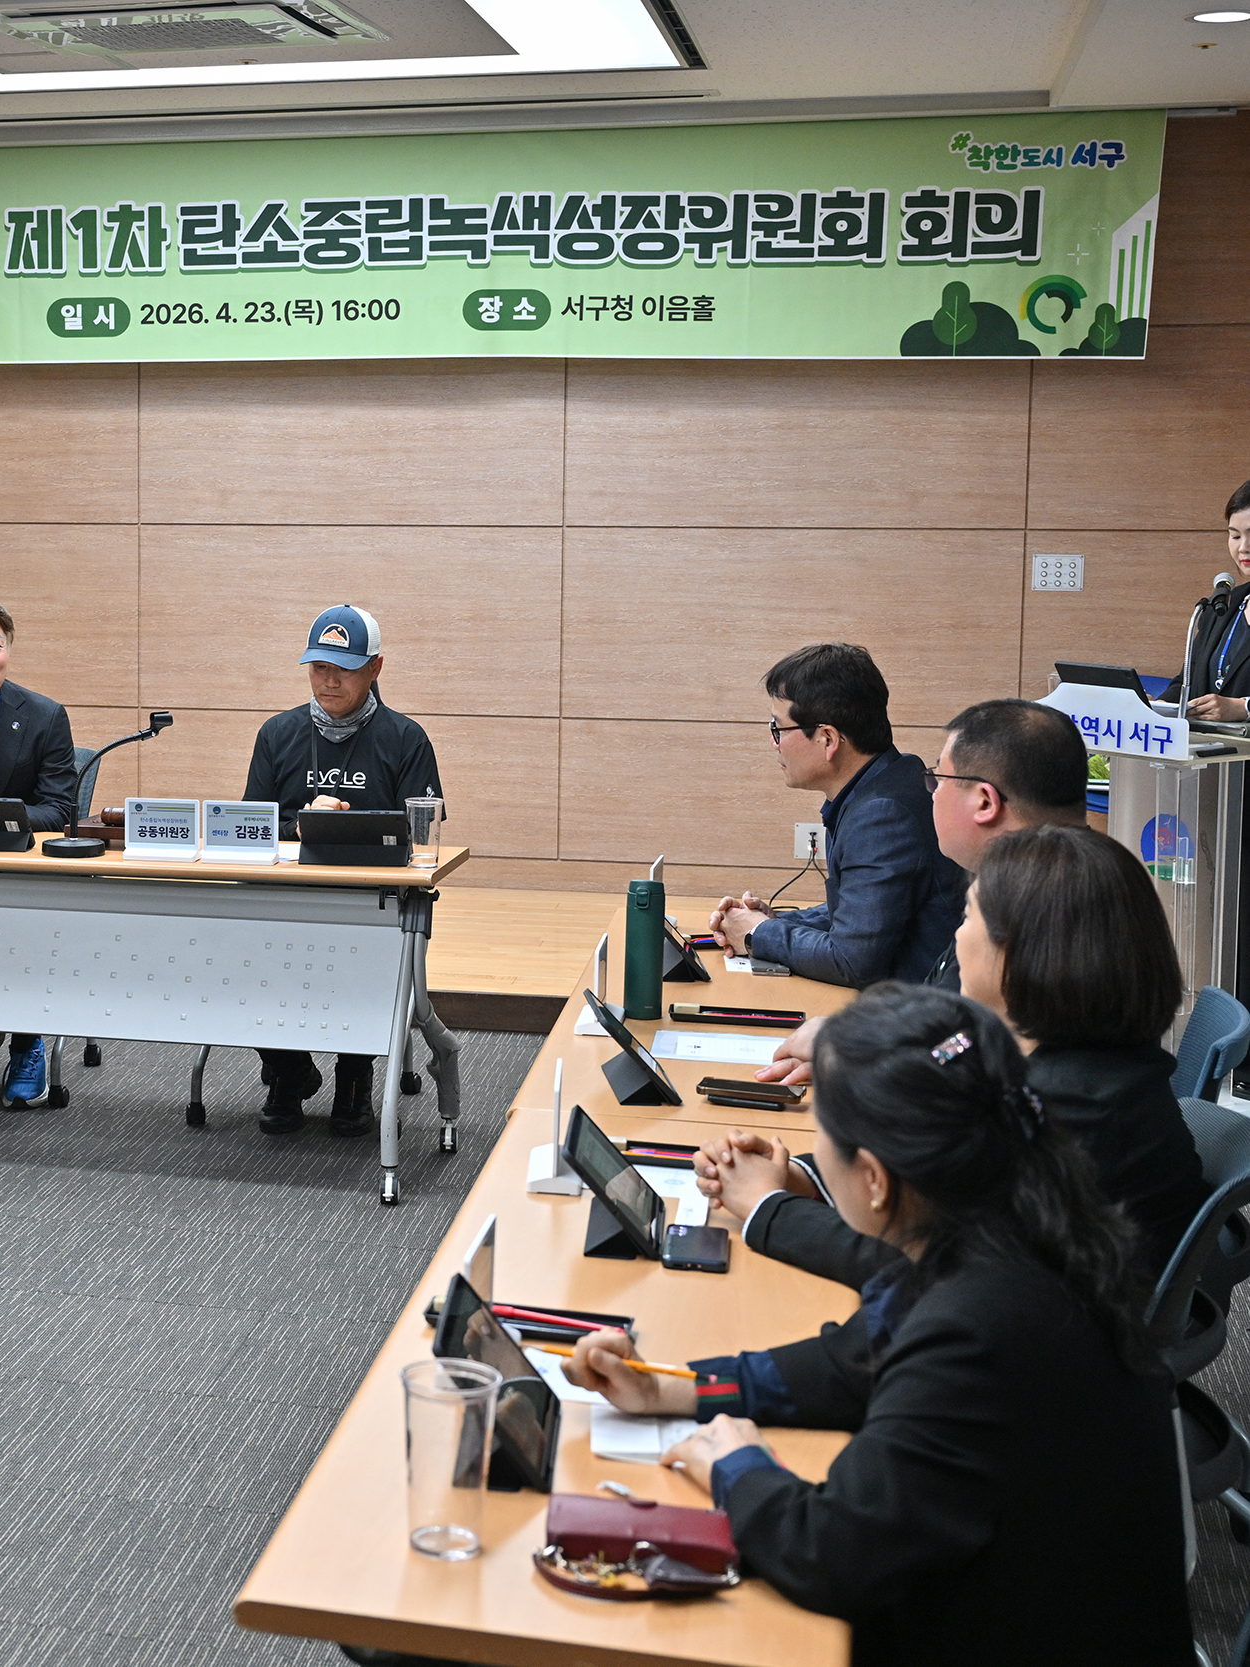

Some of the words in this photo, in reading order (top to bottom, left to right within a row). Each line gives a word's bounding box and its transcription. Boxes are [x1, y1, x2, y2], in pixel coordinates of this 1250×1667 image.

[1070, 140, 1126, 170] 서구
[5, 202, 170, 274] 제1차
[179, 189, 888, 273] 탄소중립녹색성장위원회
[899, 187, 1043, 262] 회의
[140, 302, 210, 326] 2026.
[216, 302, 238, 325] 4.
[244, 299, 325, 327] 23.(목)
[331, 298, 402, 322] 16:00
[560, 295, 634, 322] 서구청
[641, 295, 717, 322] 이음홀
[1070, 714, 1123, 749] 역시
[1129, 722, 1174, 755] 서구
[137, 825, 190, 840] 공동위원장
[211, 829, 229, 837] 센터장
[234, 825, 273, 841] 김광훈
